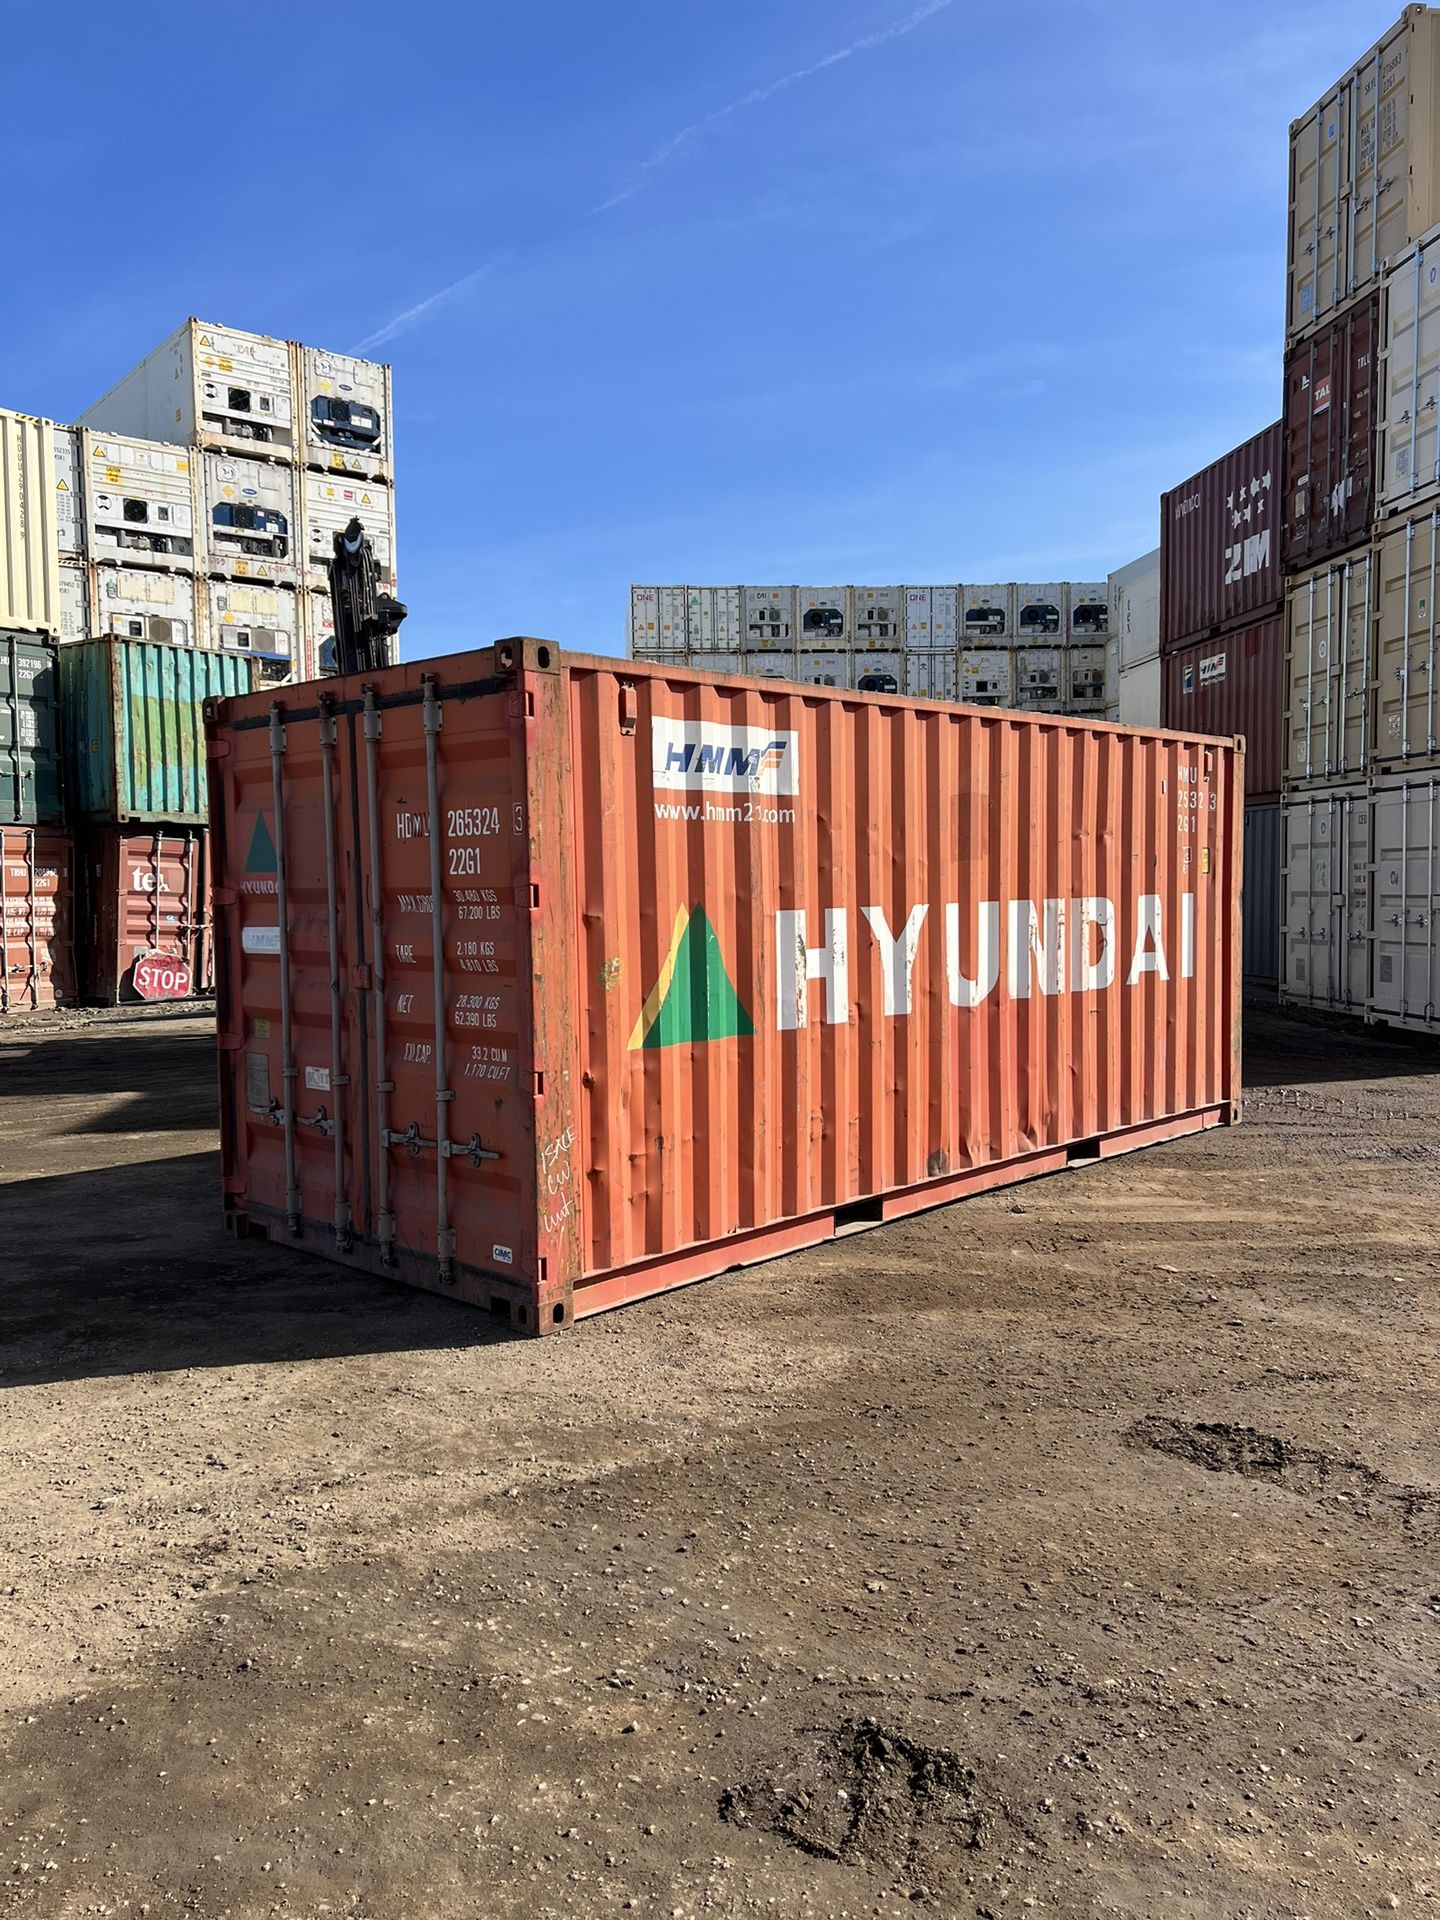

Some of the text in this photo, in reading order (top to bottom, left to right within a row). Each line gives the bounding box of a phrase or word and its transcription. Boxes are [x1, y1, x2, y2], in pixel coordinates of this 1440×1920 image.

[1314, 384, 1330, 401] TAL
[1224, 528, 1270, 585] ZIM
[636, 593, 654, 601] ONE
[17, 657, 42, 670] 392196
[447, 807, 500, 837] 265324
[448, 848, 481, 875] 22G1
[482, 889, 498, 902] KGS
[458, 905, 501, 920] 67.200 LBS
[395, 941, 495, 963] TARE 2.180 KGS
[459, 959, 499, 972] 4.810 LBS
[776, 892, 1194, 1031] HYUNDAI
[137, 967, 188, 991] STOP
[397, 994, 501, 1013] NET 28.300 KGS
[454, 1011, 497, 1028] 62.390 LBS
[471, 1046, 488, 1061] 33.2
[464, 1063, 487, 1078] 1.170
